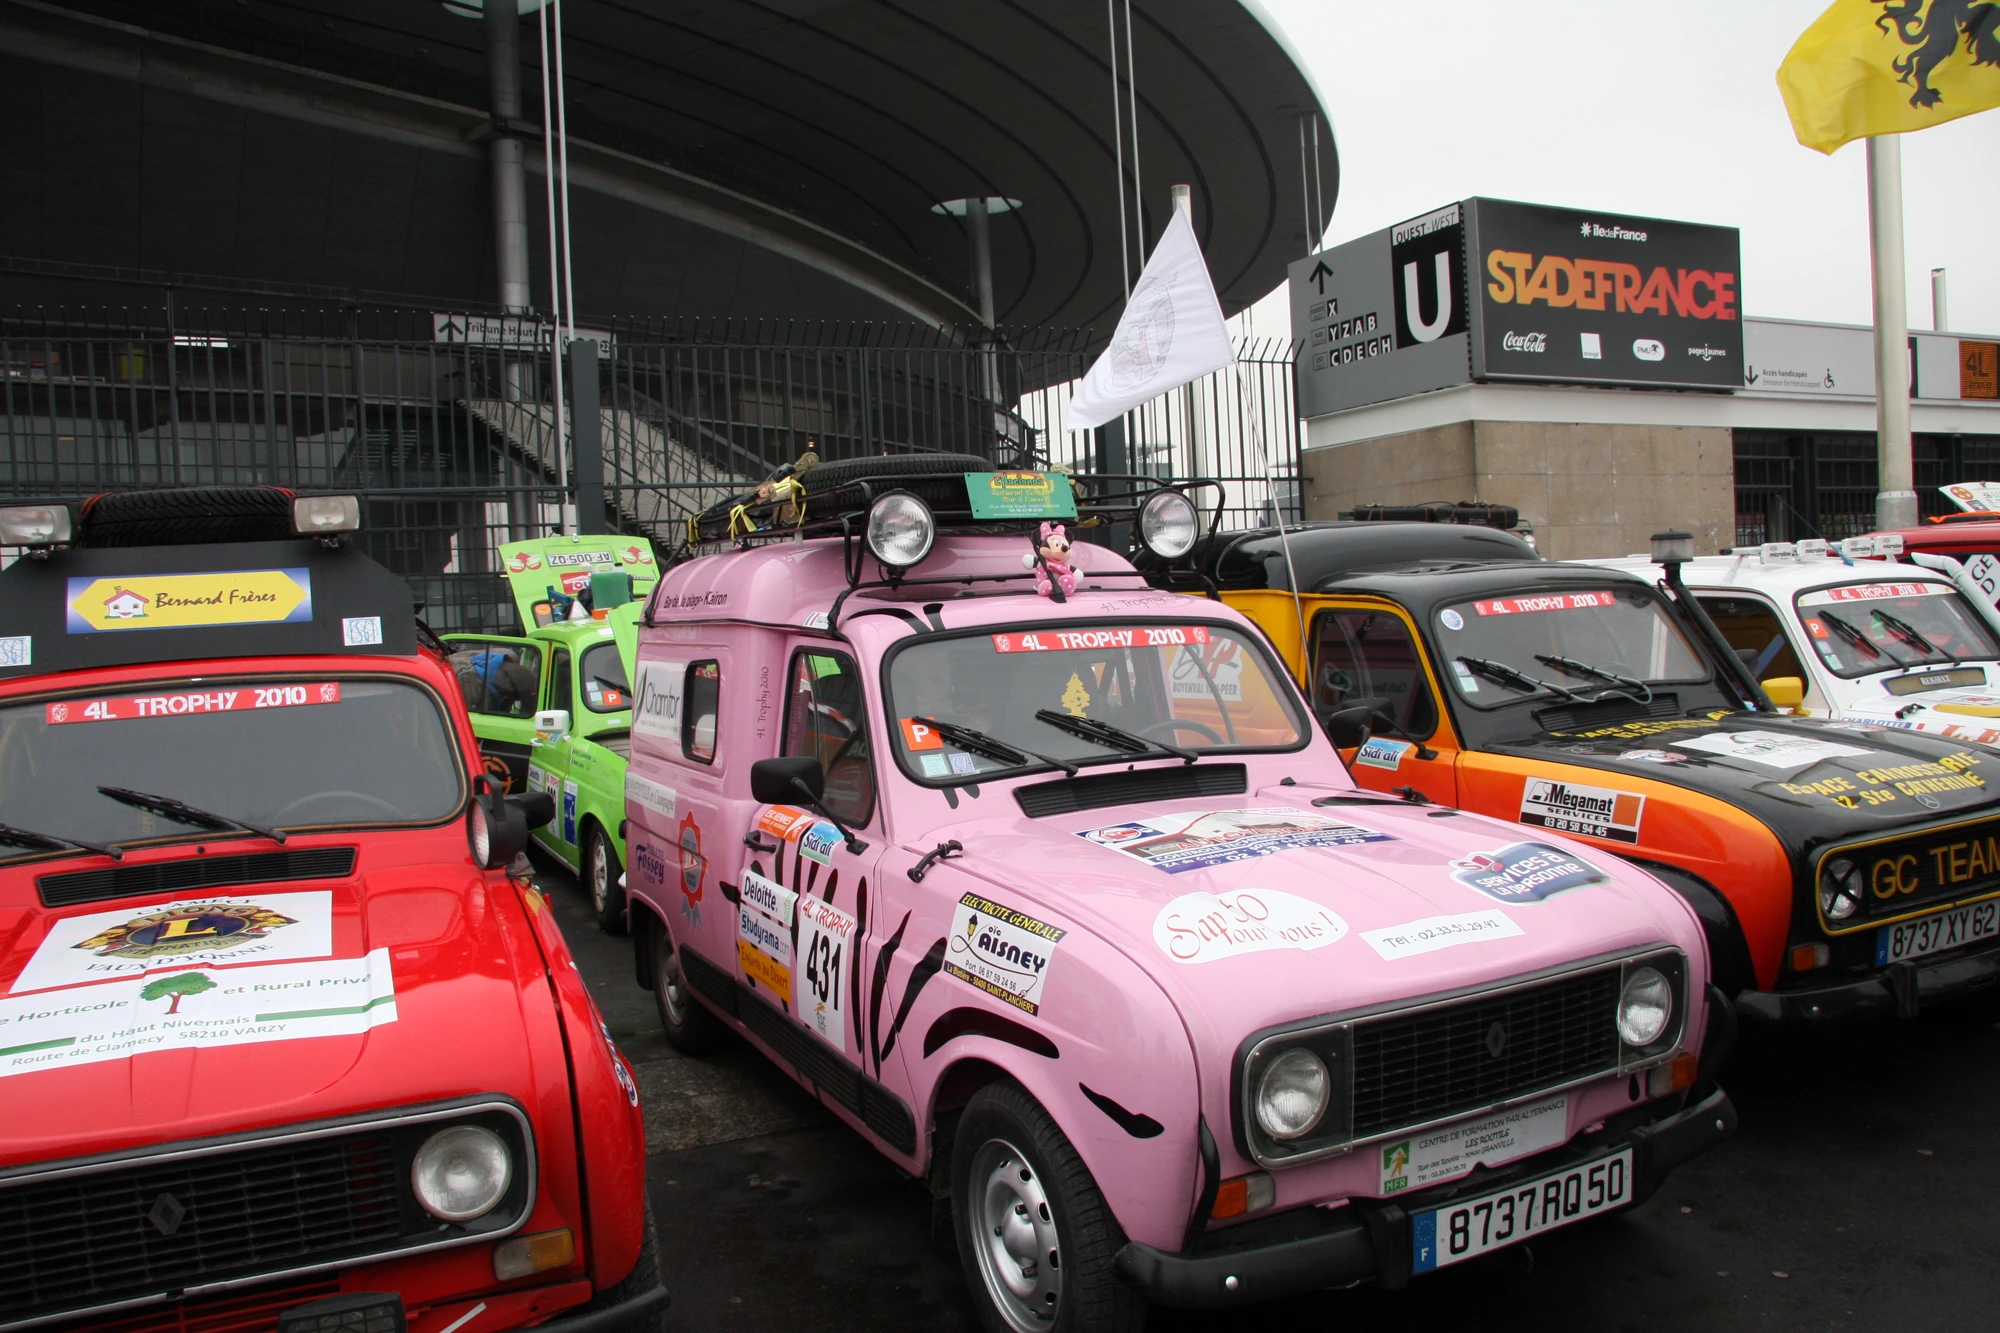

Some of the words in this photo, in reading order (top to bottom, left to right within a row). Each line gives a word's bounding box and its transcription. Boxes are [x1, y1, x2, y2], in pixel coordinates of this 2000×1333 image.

[1404, 251, 1452, 342] U
[1329, 302, 1337, 317] X
[1330, 326, 1338, 342] Y
[1342, 323, 1350, 339] Z
[1355, 320, 1363, 336] A
[1367, 316, 1376, 331] B
[1331, 351, 1339, 366] C
[1343, 349, 1352, 364] D
[1356, 345, 1364, 361] E
[1368, 342, 1378, 357] G
[1381, 338, 1391, 354] H
[1503, 331, 1547, 352] Coca-Cola
[1762, 369, 1777, 377] Accès
[1778, 369, 1807, 379] handicapés
[155, 590, 223, 609] Bernard
[229, 590, 277, 605] Frères
[1841, 590, 1855, 600] 4L
[1856, 586, 1893, 599] TROPHY
[1894, 584, 1917, 596] 2010
[1492, 601, 1511, 614] 4L
[1514, 596, 1565, 612] TROPHY
[1569, 594, 1599, 608] 2010
[1021, 634, 1049, 650] 4L
[1056, 630, 1133, 649] TROPHY
[1144, 628, 1186, 646] 2010
[1809, 623, 1820, 634] P
[759, 666, 770, 689] 2010
[1919, 674, 1951, 686] RENAULT
[84, 702, 117, 720] 4L
[134, 691, 239, 717] TROPHY
[254, 685, 307, 708] 2010
[608, 693, 617, 703] P
[756, 691, 772, 723] Trophy
[911, 724, 930, 743] P
[1360, 745, 1383, 760] Sidi
[1382, 750, 1400, 763] ali
[1549, 783, 1613, 813] Mégamat
[1858, 789, 1897, 806] Ste
[1894, 770, 1986, 797] CATHERINE
[1547, 806, 1611, 823] SERVICES
[1544, 816, 1556, 827] 03
[1556, 818, 1568, 830] 20
[1568, 821, 1580, 832] 58
[1581, 824, 1594, 835] 94
[1594, 826, 1608, 837] 45
[803, 832, 823, 852] Sidi
[819, 840, 835, 857] ali
[635, 844, 665, 885] Fossey
[1225, 852, 1253, 862] 02
[1872, 854, 1919, 899] GC
[157, 917, 218, 940] L
[802, 899, 815, 919] 4L
[815, 905, 854, 939] TROPHY
[961, 894, 1011, 921] ELECTRICITE
[1008, 913, 1063, 942] GENERALE
[1166, 911, 1233, 960] Sap
[1382, 935, 1411, 948] Tel
[1891, 916, 1943, 958] 8737
[1946, 909, 1970, 945] XY
[1972, 902, 1995, 937] 62
[154, 945, 274, 966] D'YONNE
[806, 929, 842, 1012] 431
[964, 959, 979, 973] Port.
[978, 965, 986, 977] 06
[985, 968, 993, 980] 87
[993, 974, 1001, 985] 59
[1000, 977, 1009, 988] 24
[1008, 980, 1017, 992] 56
[17, 999, 130, 1023] Horticole
[223, 986, 247, 996] et
[253, 977, 313, 994] Rural
[319, 971, 373, 987] Privé
[986, 983, 1035, 1014] SAINT-PLANCHERS
[80, 1033, 105, 1044] du
[111, 1022, 157, 1039] Haut
[162, 1015, 251, 1031] Nivernais
[11, 1052, 65, 1067] Route
[69, 1047, 91, 1057] de
[95, 1034, 166, 1054] Clamecy
[178, 1029, 230, 1039] 58210
[233, 1023, 287, 1036] VARZY
[1418, 1133, 1449, 1150] CENTRE
[1450, 1130, 1460, 1140] DE
[1461, 1119, 1506, 1137] FORMATION
[1505, 1113, 1520, 1124] PAR
[1518, 1100, 1566, 1121] ALTERNANCE
[1465, 1135, 1480, 1149] LES
[1479, 1128, 1510, 1145] ROUTILS
[1480, 1138, 1515, 1154] GRANVILLE
[1386, 1177, 1406, 1192] MFR
[1449, 1186, 1537, 1256] 8737
[1542, 1172, 1582, 1225] RQ
[1587, 1157, 1624, 1209] 50
[1420, 1247, 1430, 1263] F
